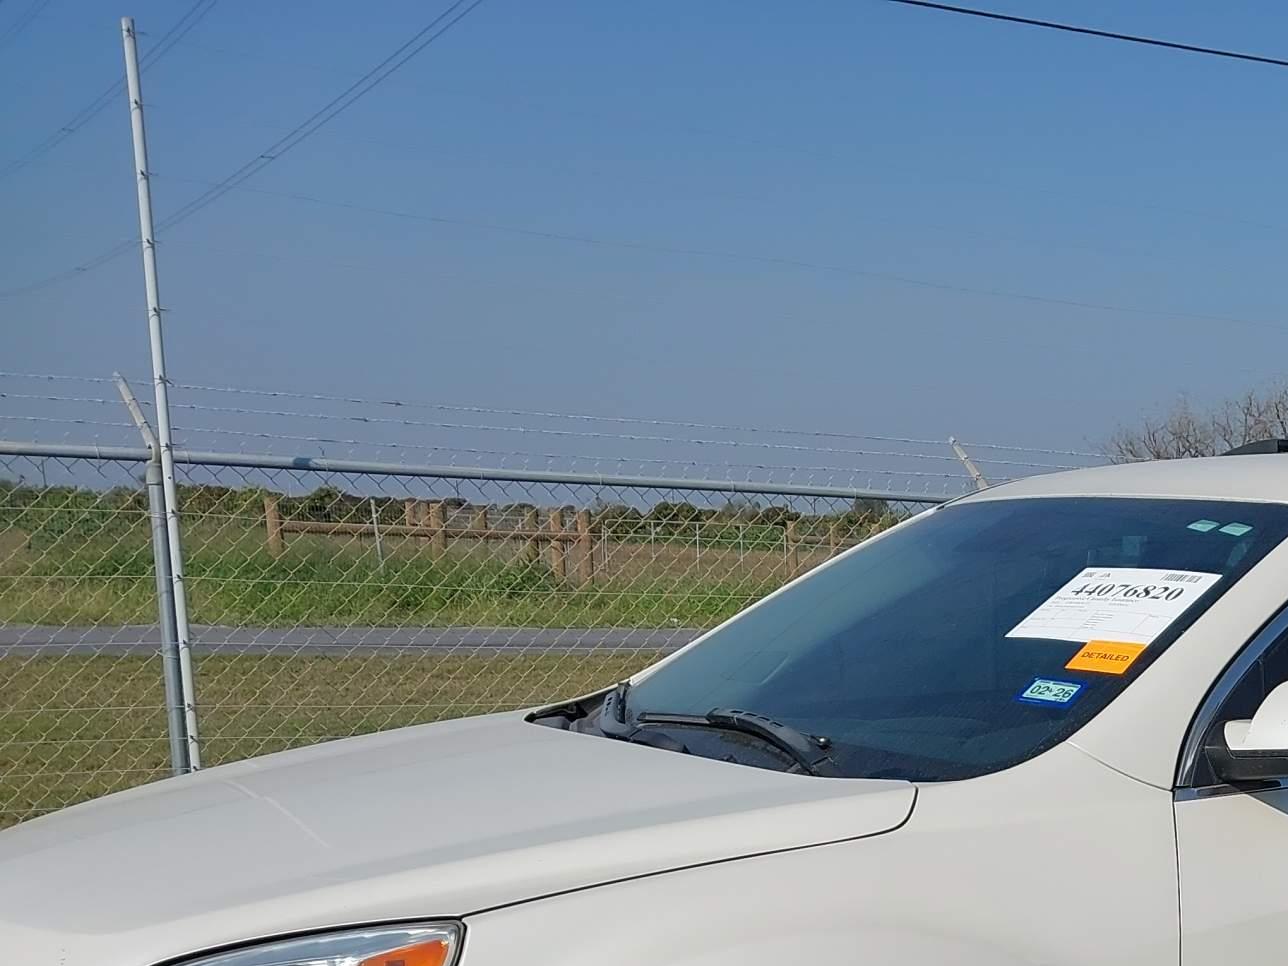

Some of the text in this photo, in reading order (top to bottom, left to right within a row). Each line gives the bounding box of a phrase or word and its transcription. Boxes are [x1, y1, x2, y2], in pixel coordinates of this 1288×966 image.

[1072, 583, 1185, 601] 44076820
[1081, 651, 1130, 662] DETAILED
[1030, 685, 1075, 699] 02 26
